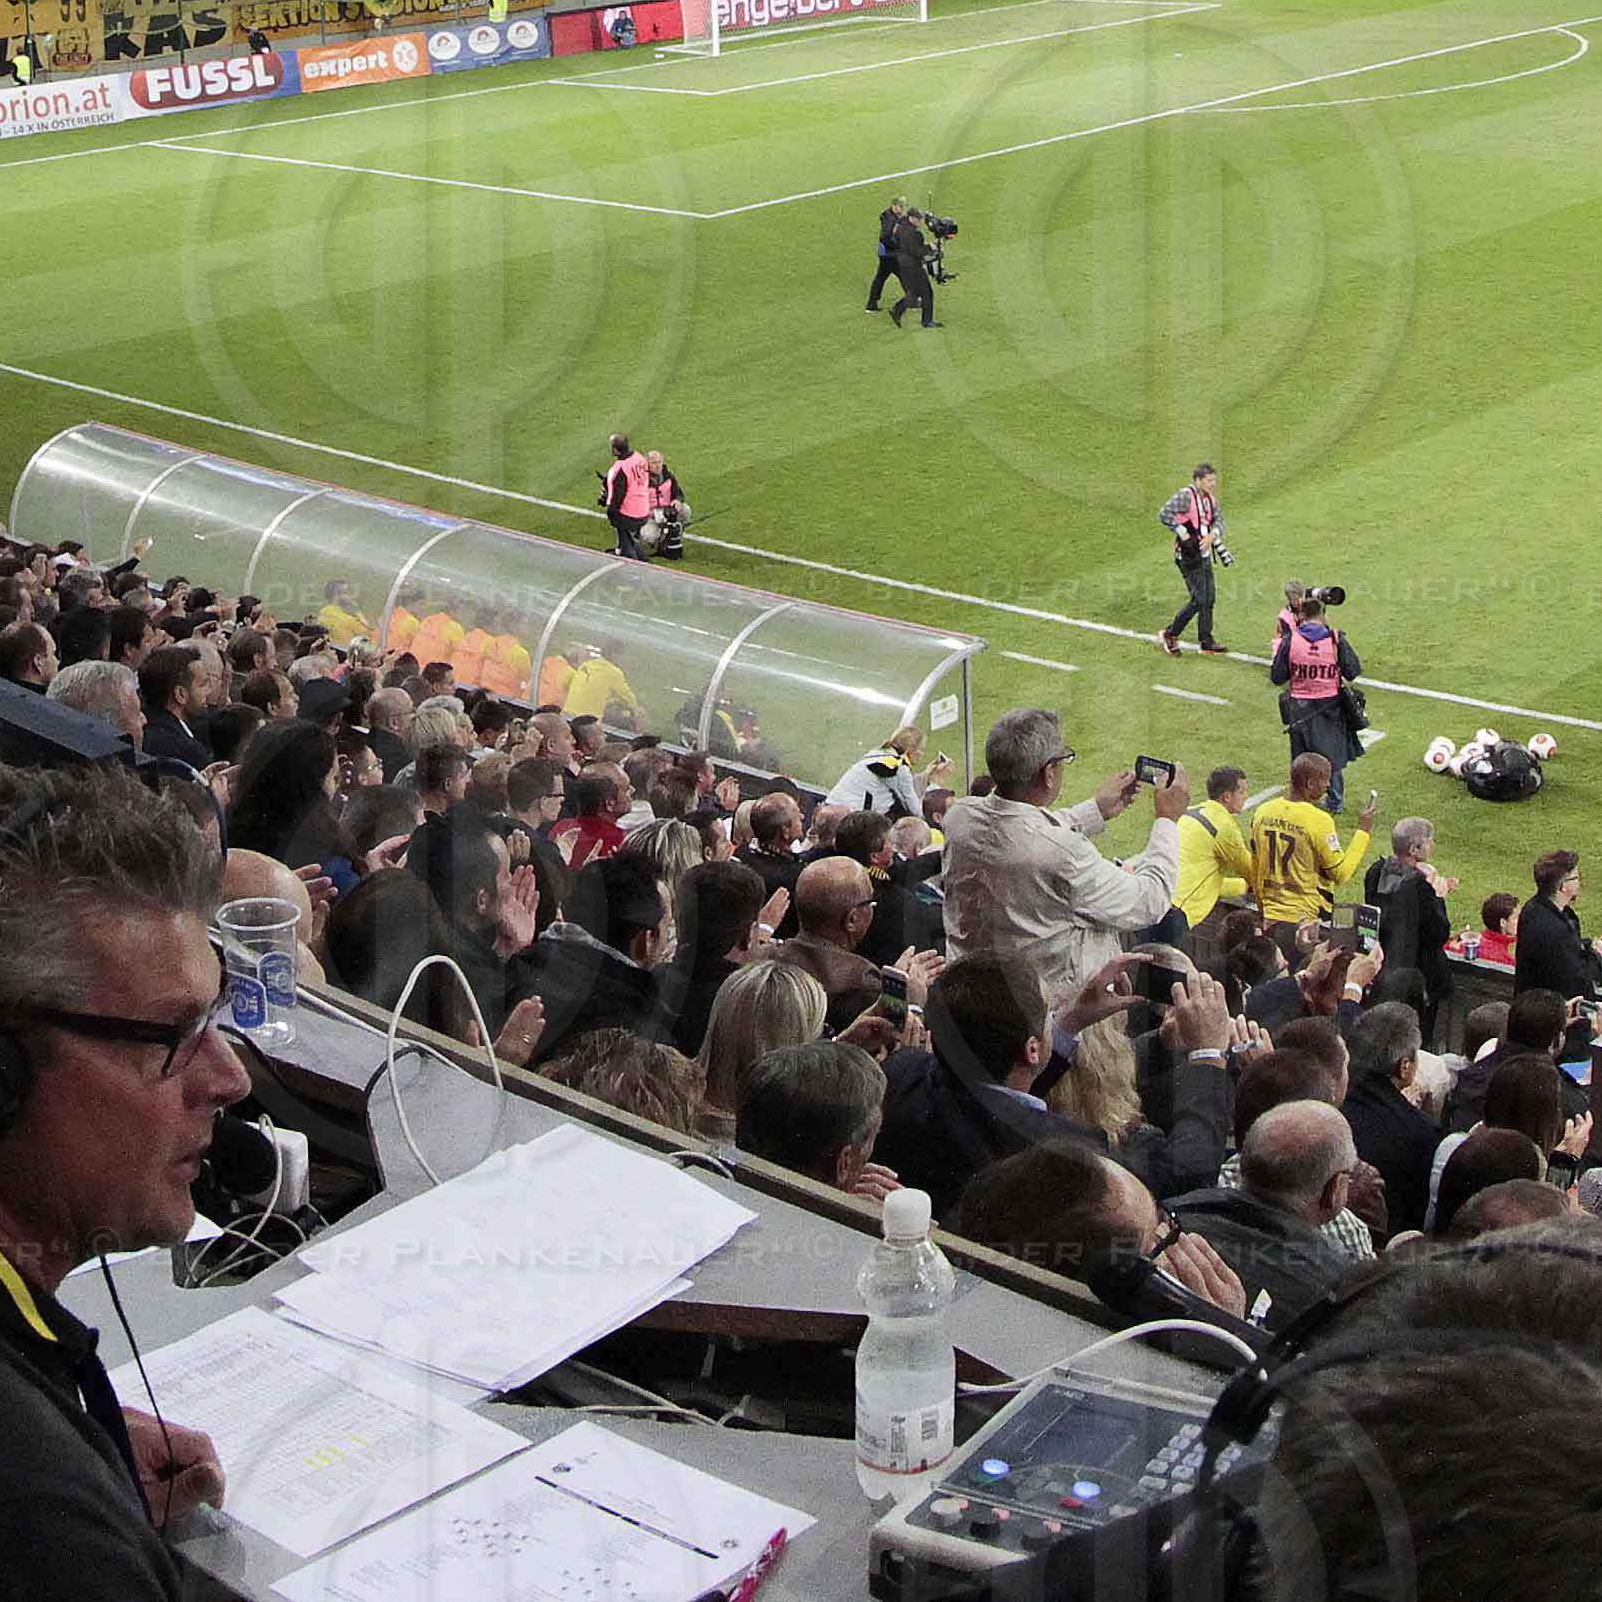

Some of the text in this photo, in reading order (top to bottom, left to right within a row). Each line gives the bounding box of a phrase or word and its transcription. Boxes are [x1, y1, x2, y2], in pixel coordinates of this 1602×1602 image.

[144, 53, 276, 103] FUSSL
[303, 49, 389, 79] expert
[12, 125, 25, 136] 14
[51, 113, 115, 129] ÖSTERREICH
[1290, 661, 1340, 681] PHOTO
[1264, 829, 1296, 877] 17
